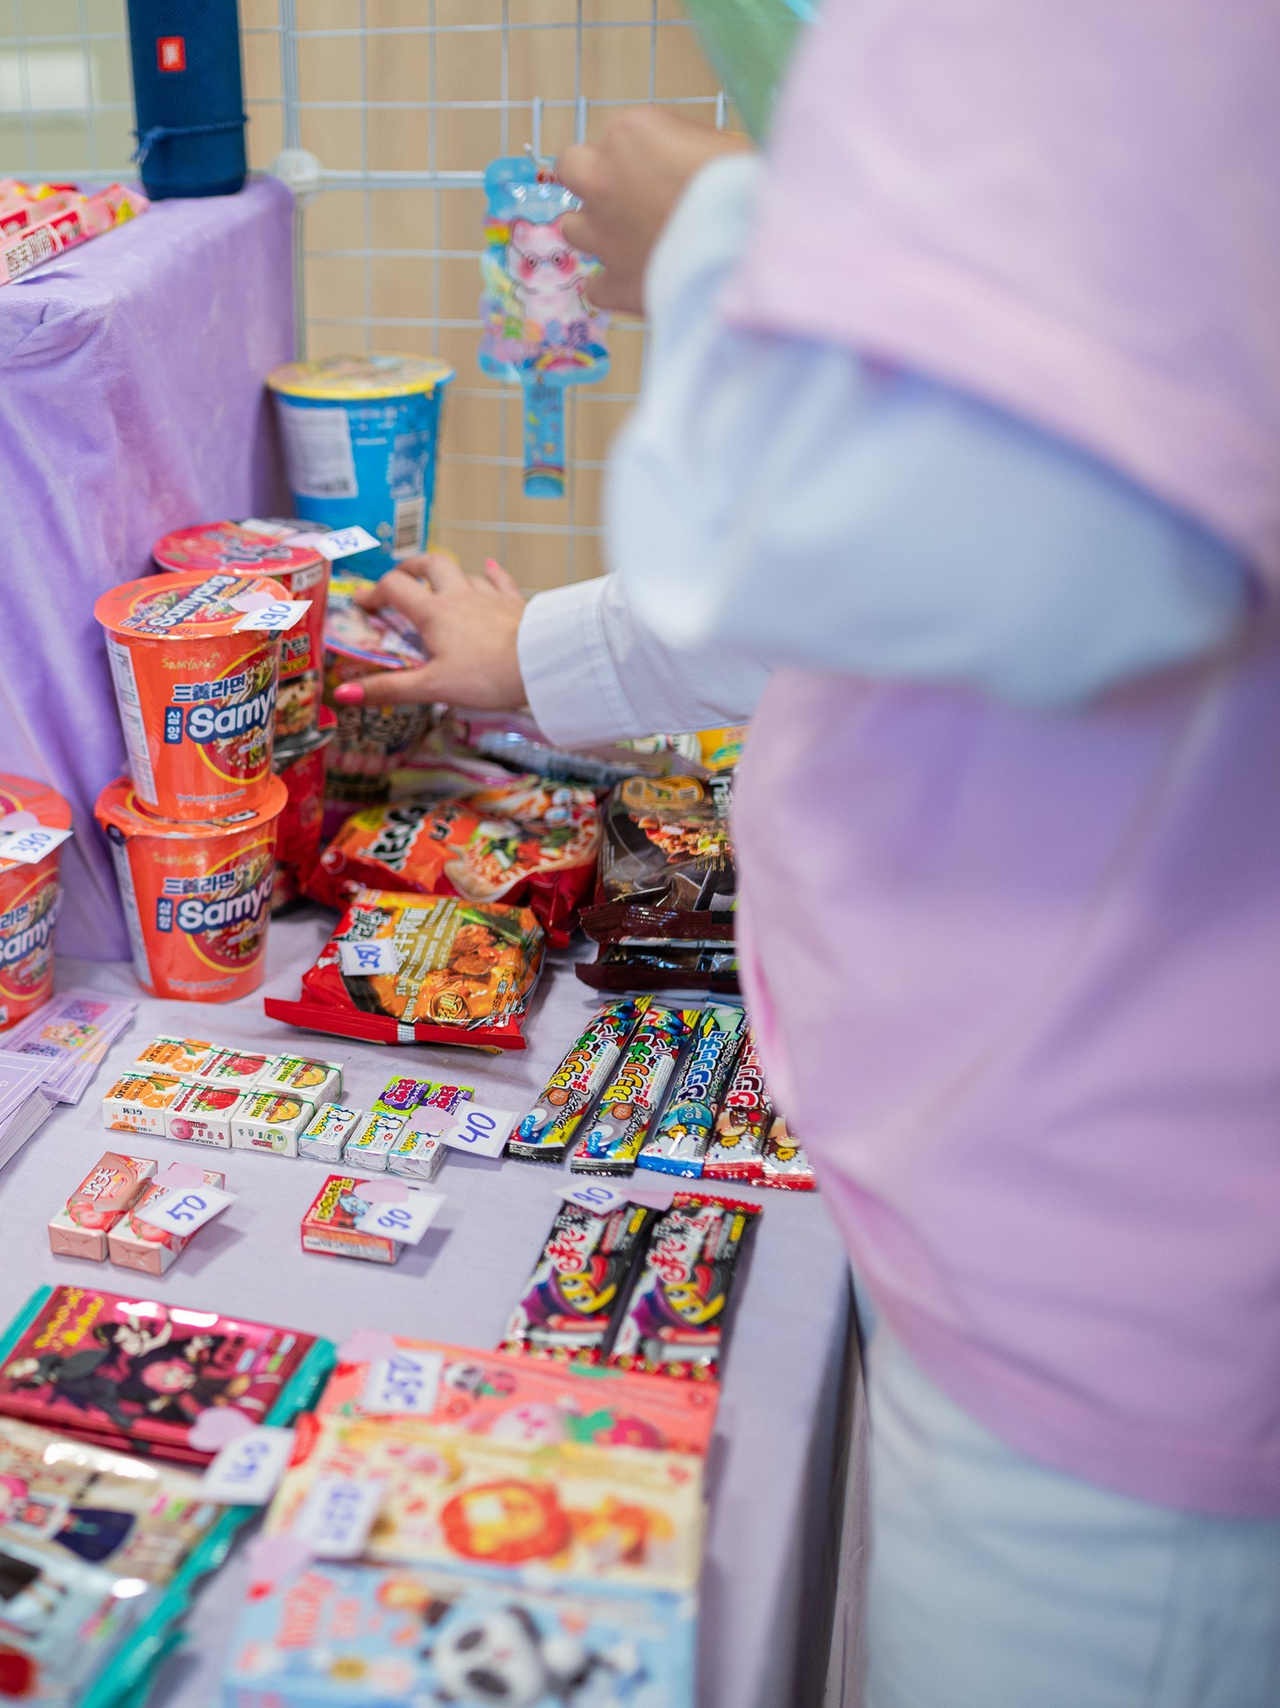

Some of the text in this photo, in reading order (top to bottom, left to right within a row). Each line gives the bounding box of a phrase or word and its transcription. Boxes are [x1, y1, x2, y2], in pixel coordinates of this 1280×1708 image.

[254, 602, 293, 629] 290
[166, 709, 181, 741] 삼양
[10, 832, 53, 855] 390
[354, 943, 382, 970] 250
[122, 1106, 144, 1116] GUM
[457, 1111, 497, 1144] 40
[170, 1194, 208, 1222] 50
[571, 1185, 614, 1207] 90
[376, 1207, 414, 1231] 90
